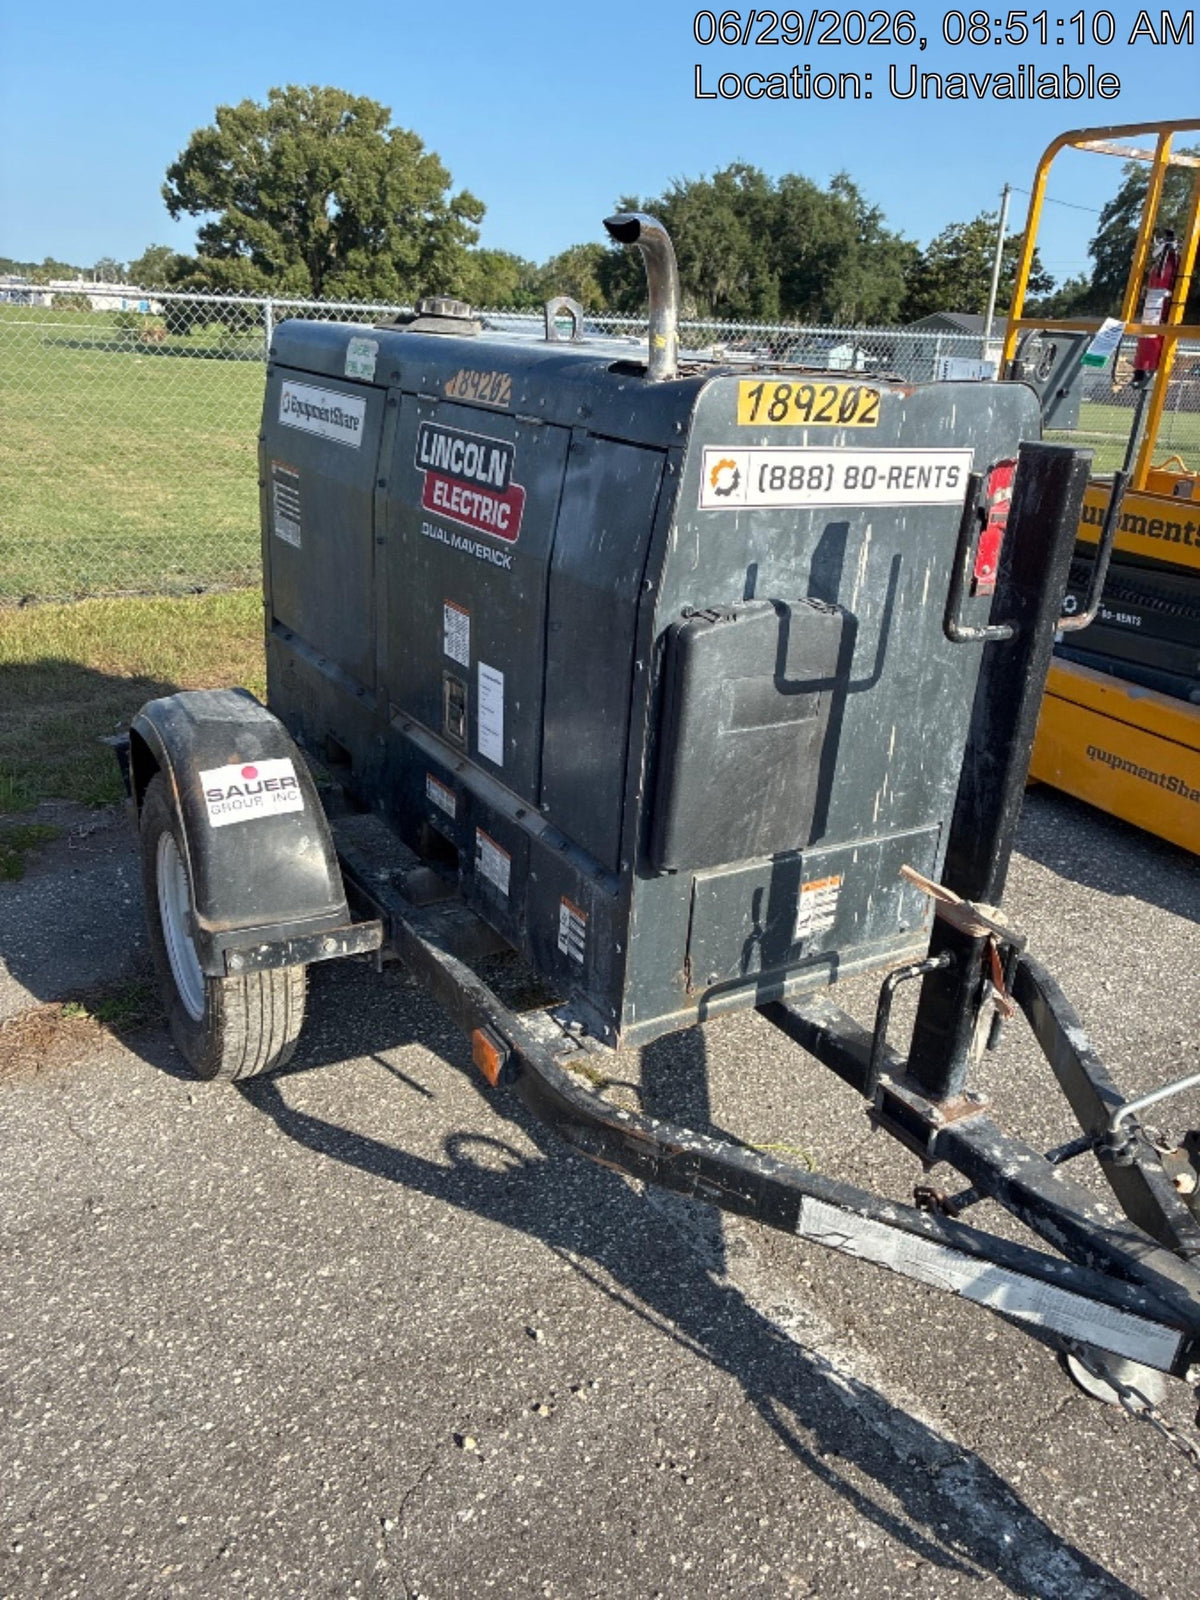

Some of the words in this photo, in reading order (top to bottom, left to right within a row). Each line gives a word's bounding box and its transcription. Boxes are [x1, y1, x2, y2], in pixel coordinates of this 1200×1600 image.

[291, 395, 360, 431] EquipmentShare
[748, 383, 880, 423] 189202
[420, 430, 508, 488] LINCOLN
[758, 463, 834, 493] (888)
[843, 464, 960, 491] 80-RENTS
[432, 479, 512, 530] ELECTRIC
[421, 521, 450, 545] DUAL
[450, 531, 513, 570] MAVERICK
[206, 776, 298, 802] SAUER
[271, 790, 298, 803] INC
